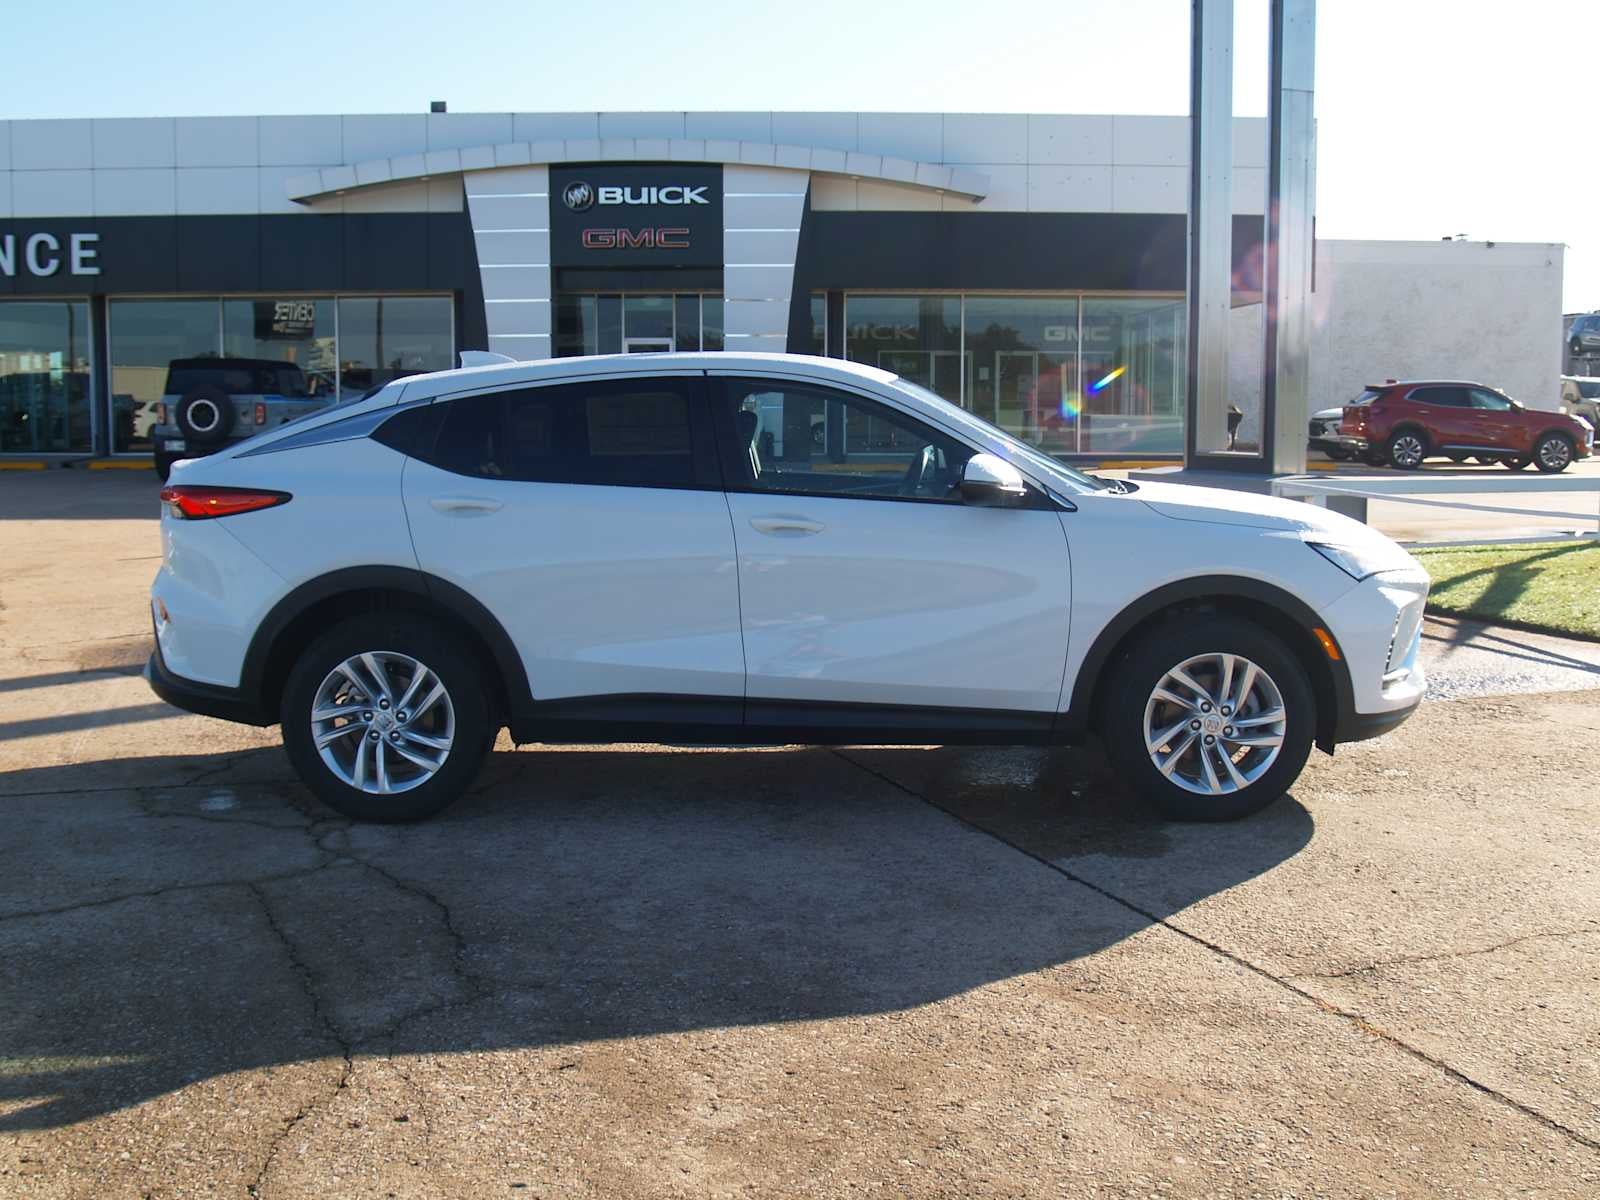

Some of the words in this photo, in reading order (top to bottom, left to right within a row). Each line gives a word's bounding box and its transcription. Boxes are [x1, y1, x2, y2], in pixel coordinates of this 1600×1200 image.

[598, 186, 710, 205] BUICK
[582, 228, 690, 249] GMC
[1044, 325, 1111, 341] GMC
